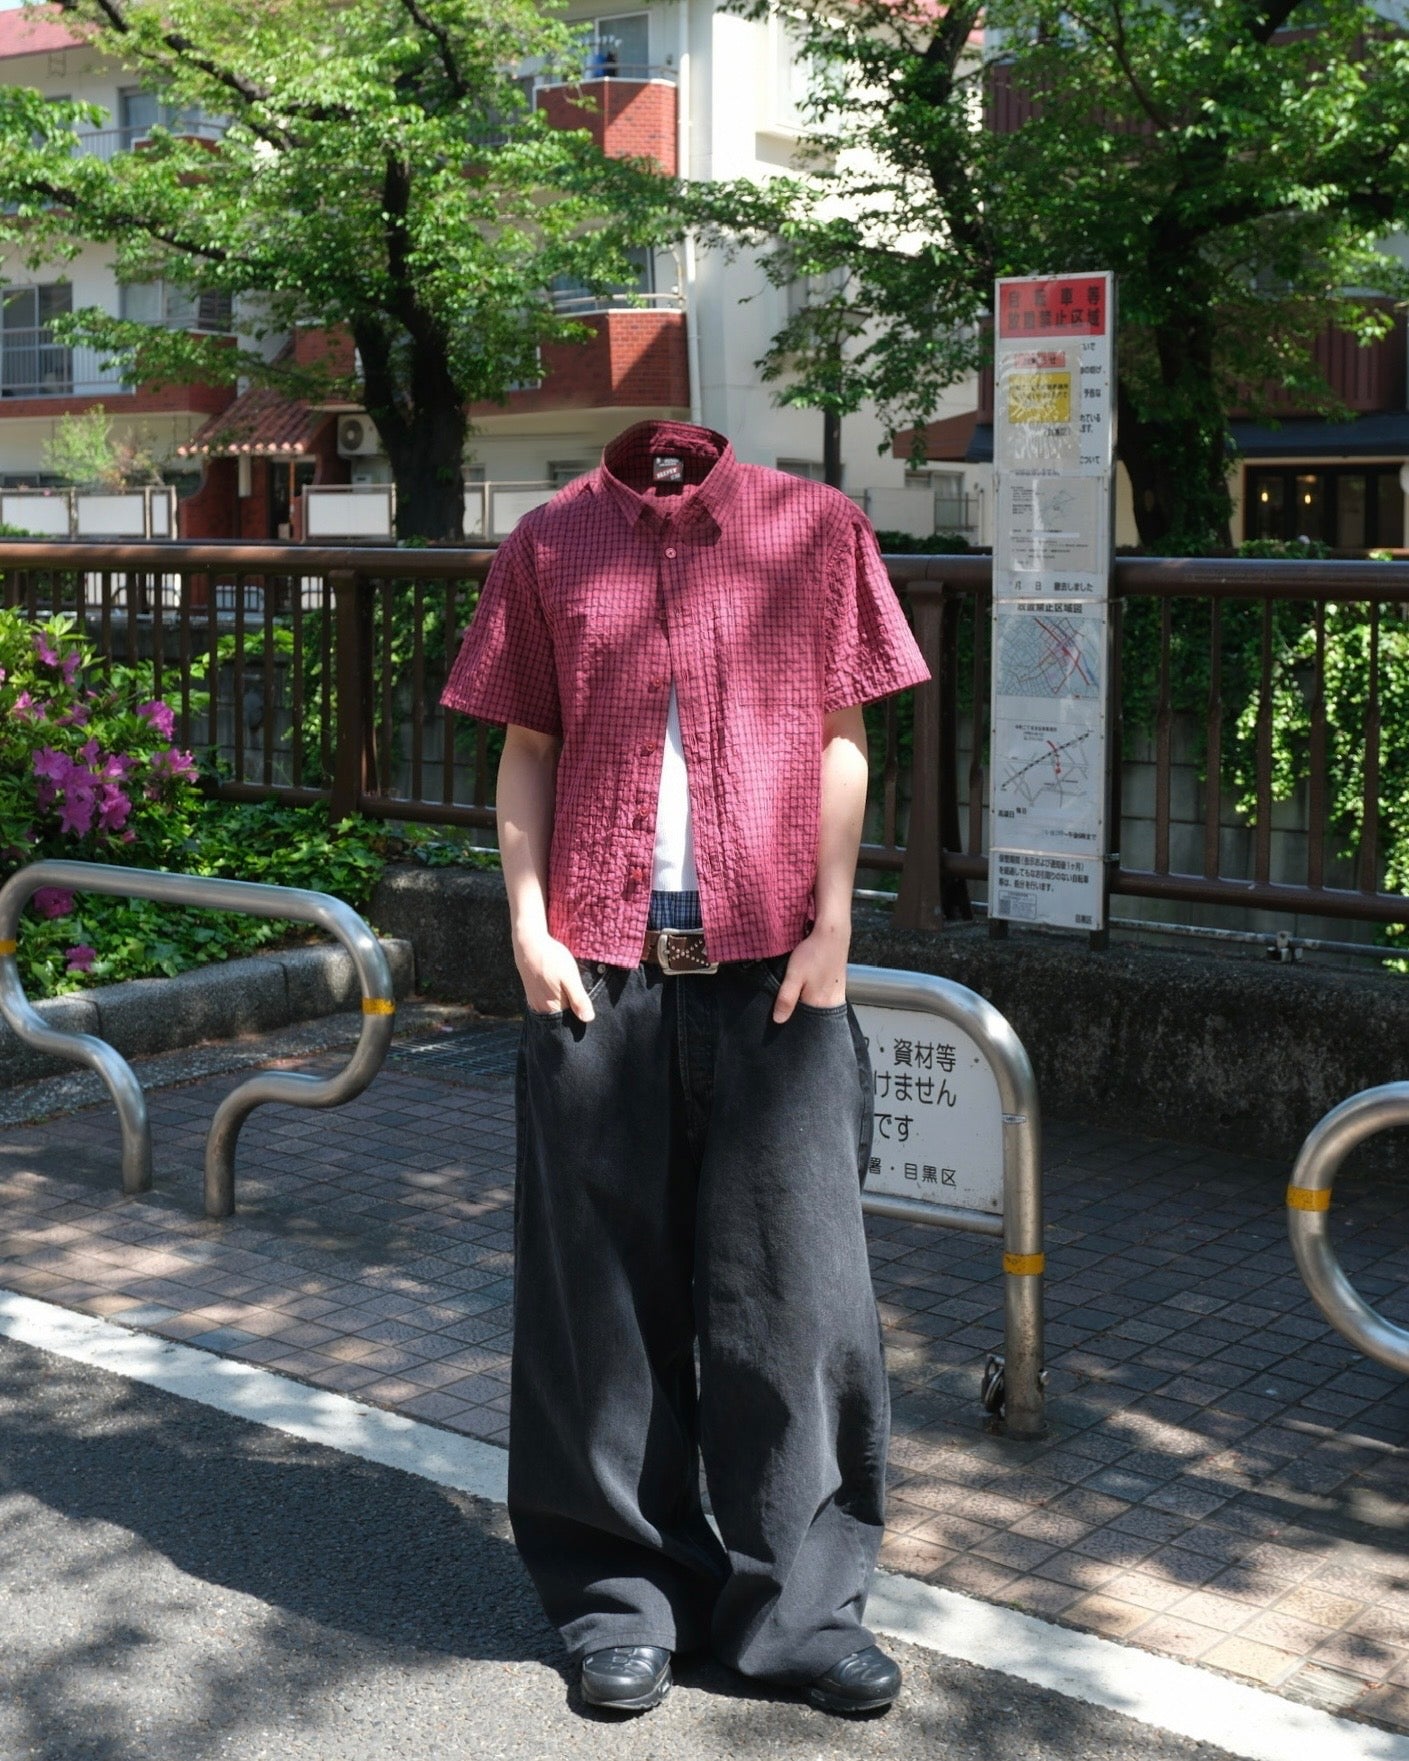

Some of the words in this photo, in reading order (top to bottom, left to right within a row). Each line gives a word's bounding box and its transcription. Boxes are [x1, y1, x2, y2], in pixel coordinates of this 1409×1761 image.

[864, 1037, 957, 1073] ・資材等
[874, 1070, 957, 1107] けません
[874, 1113, 913, 1142] です
